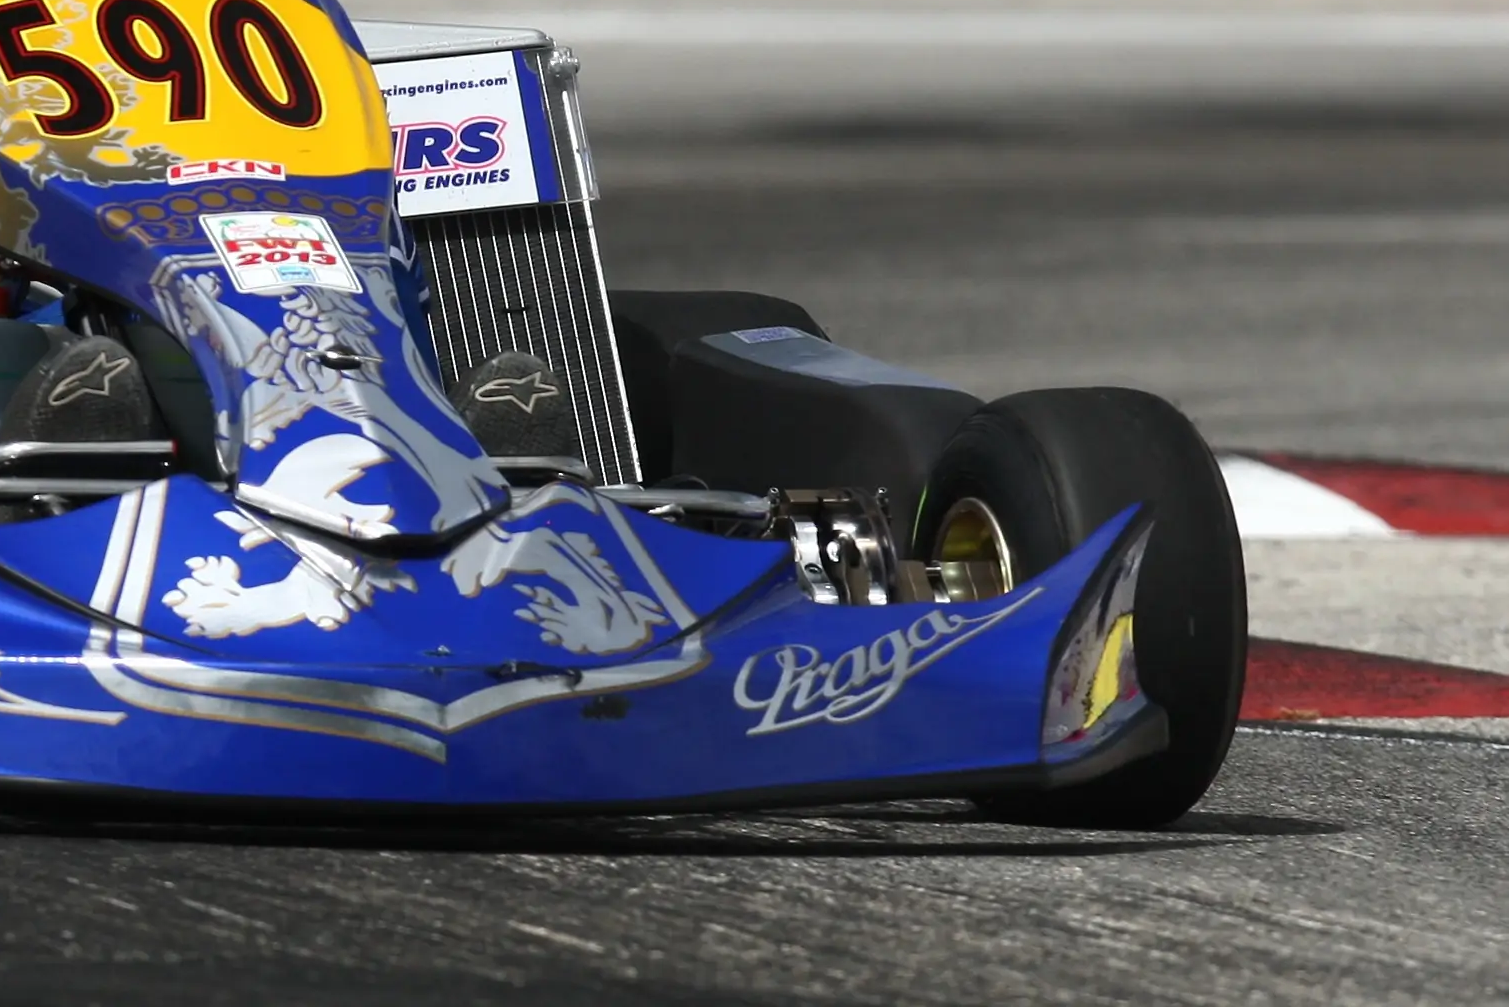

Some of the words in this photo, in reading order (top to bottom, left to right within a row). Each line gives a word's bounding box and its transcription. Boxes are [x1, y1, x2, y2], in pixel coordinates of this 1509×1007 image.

[393, 119, 503, 171] RS
[424, 168, 510, 190] ENGINES
[224, 237, 328, 253] FWT
[235, 251, 337, 267] 2013
[733, 587, 1045, 737] Praga
